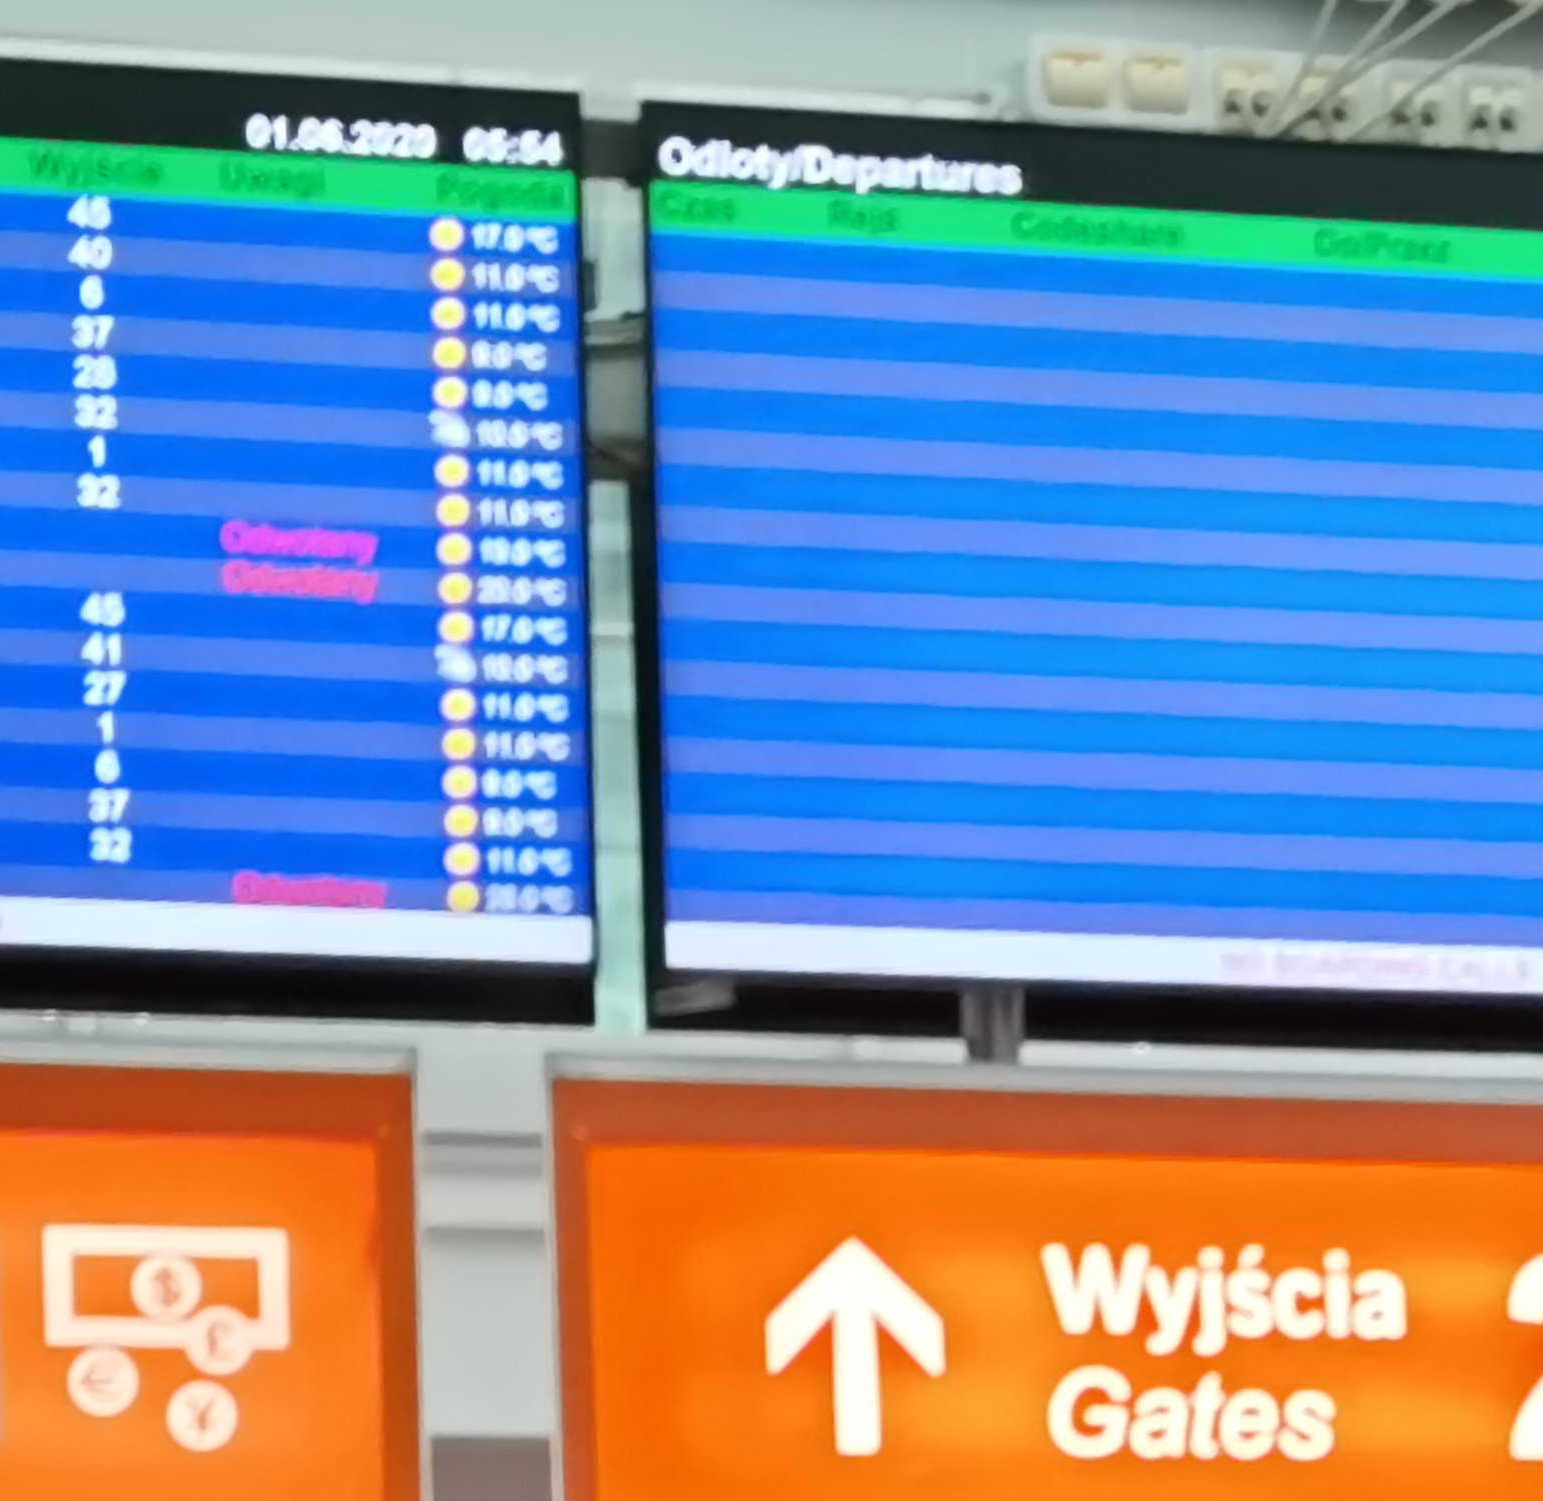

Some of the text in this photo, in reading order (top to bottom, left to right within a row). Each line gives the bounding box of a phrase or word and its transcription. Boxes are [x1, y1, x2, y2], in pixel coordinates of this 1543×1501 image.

[220, 158, 325, 200] Uwagi
[66, 234, 114, 270] 40
[71, 314, 115, 349] 37
[73, 393, 118, 430] 32
[87, 433, 106, 467] 1
[76, 473, 121, 509] 32
[79, 590, 125, 627] 45
[80, 631, 123, 666] 41
[83, 668, 127, 706] 27
[96, 710, 115, 744] 1
[87, 787, 130, 823] 37
[89, 825, 132, 864] 32
[1040, 1239, 1407, 1358] Wyjścia
[1042, 1364, 1337, 1463] Gates
